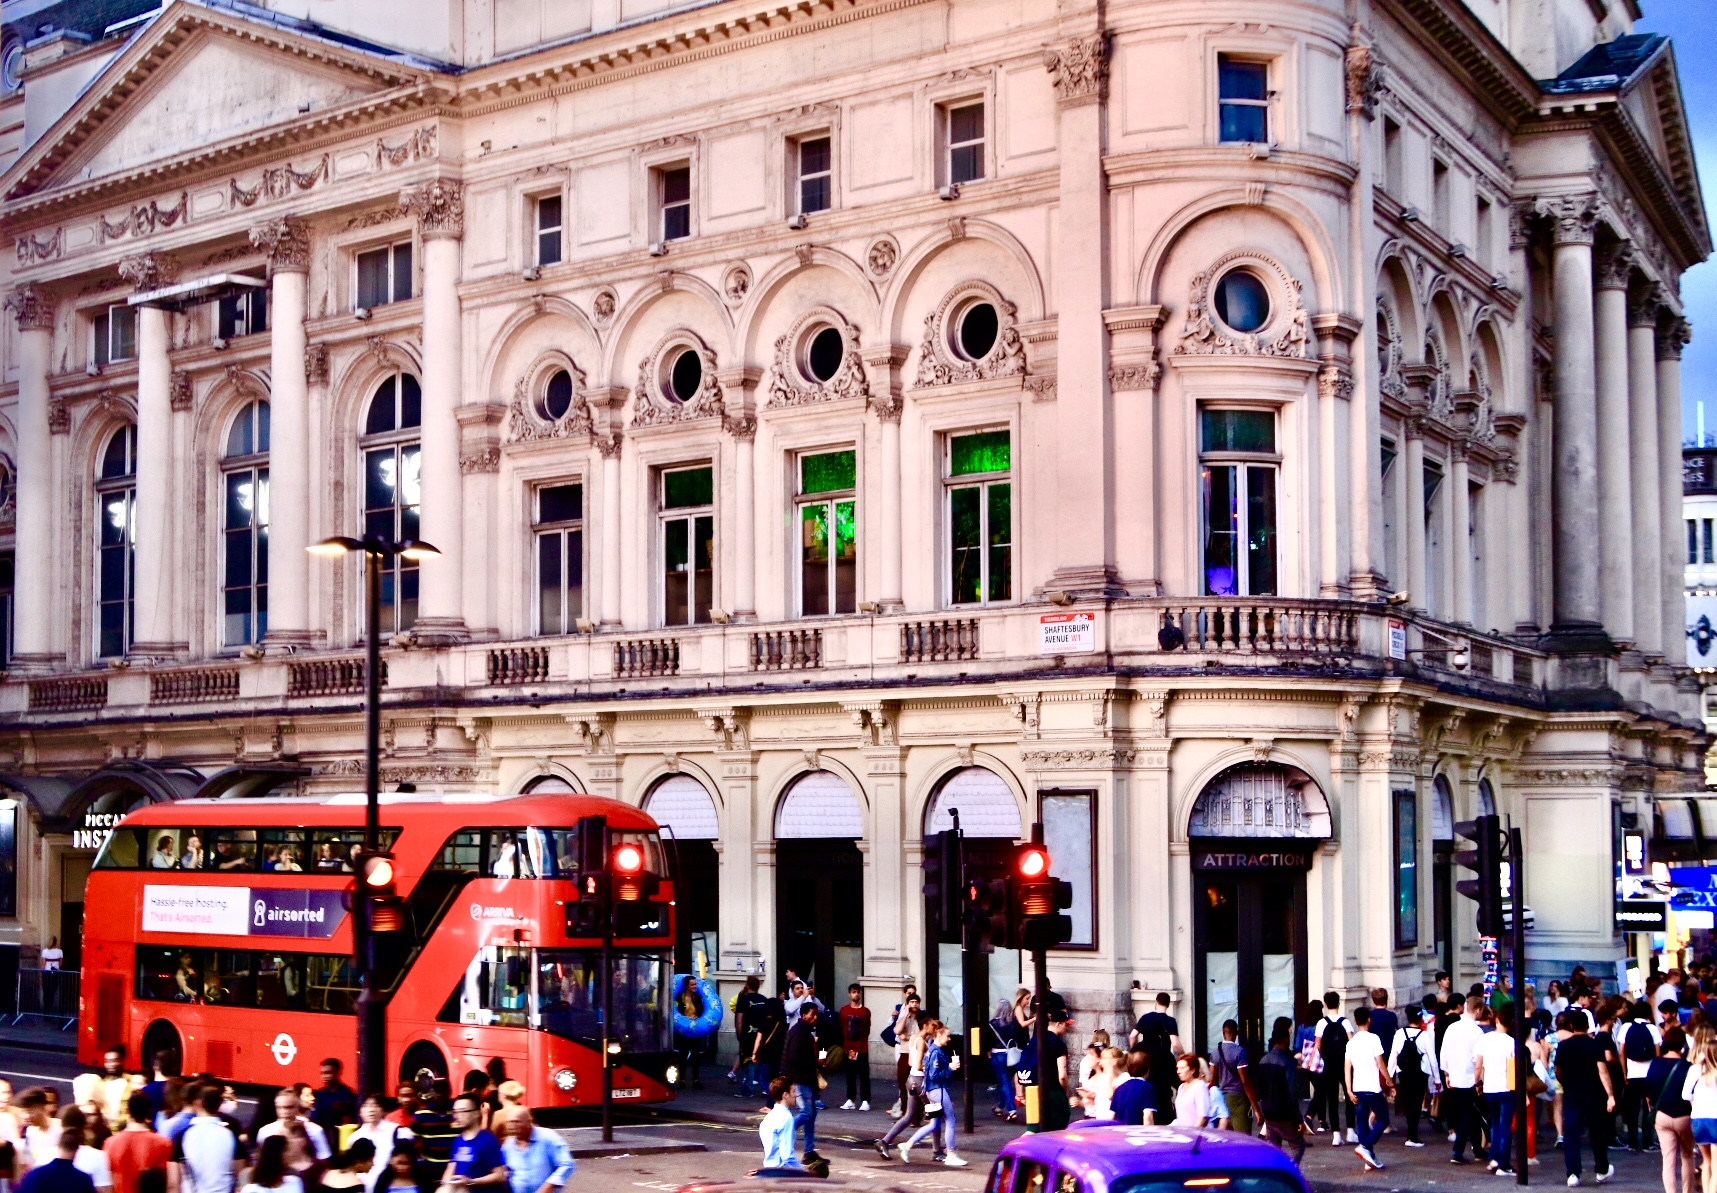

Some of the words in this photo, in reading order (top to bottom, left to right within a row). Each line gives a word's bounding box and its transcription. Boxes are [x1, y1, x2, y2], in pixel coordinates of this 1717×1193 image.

[1044, 624, 1090, 635] SHAFTESBURY
[1044, 635, 1069, 643] AVENUE
[1203, 853, 1304, 866] ATTRACTION
[151, 897, 194, 908] Hassle-free
[196, 897, 229, 911] hosting.
[267, 906, 324, 922] airsorted
[482, 906, 515, 918] ARRIVA
